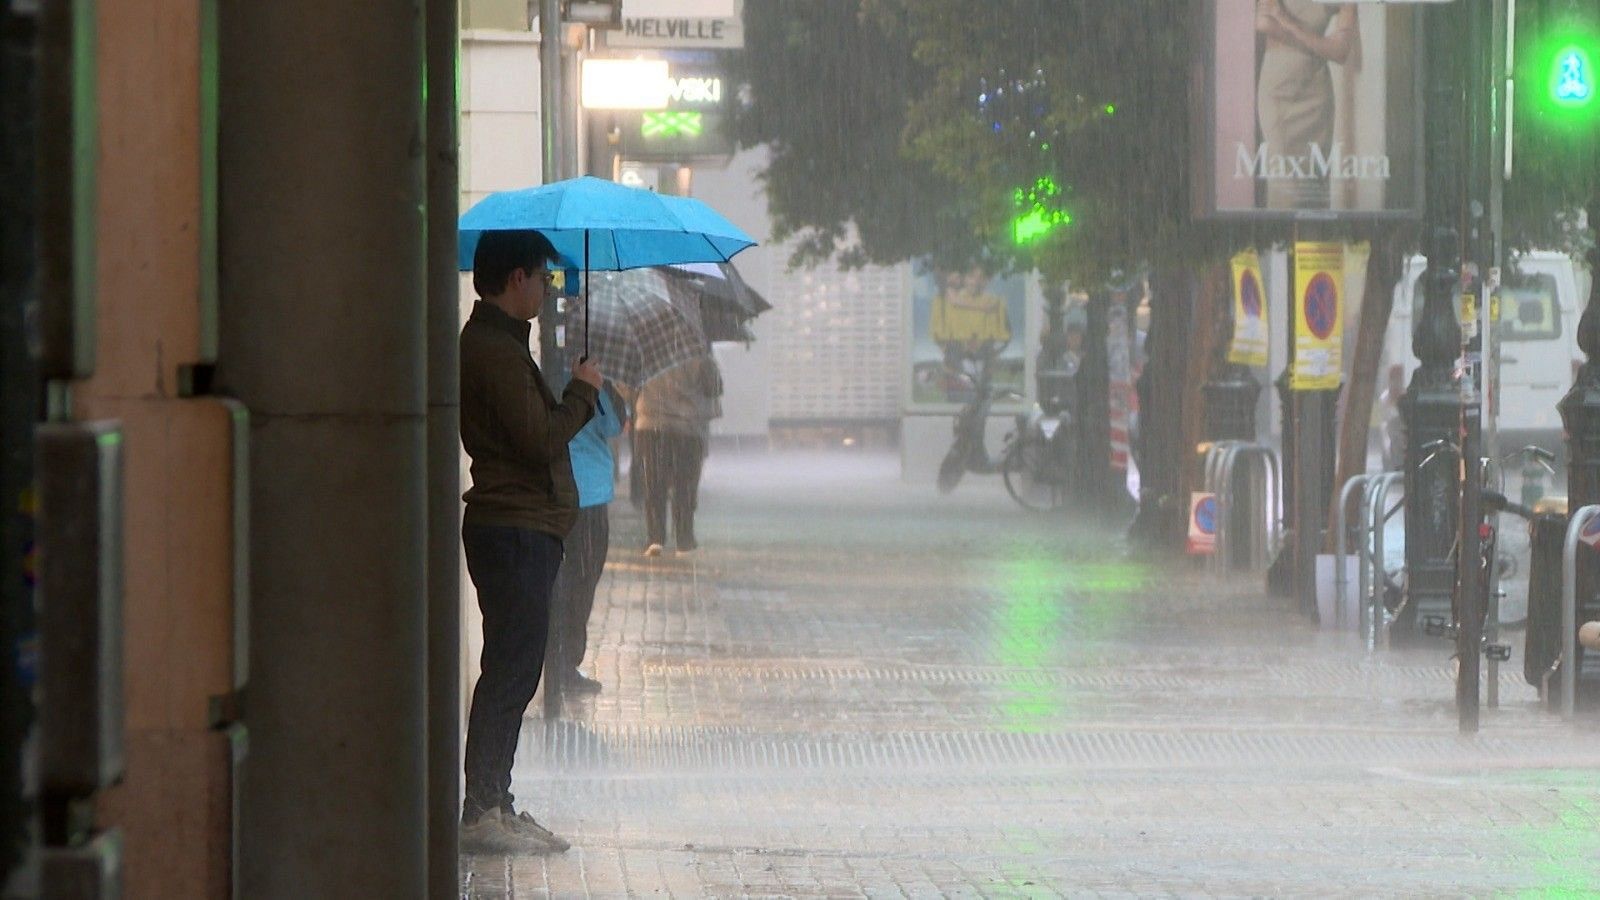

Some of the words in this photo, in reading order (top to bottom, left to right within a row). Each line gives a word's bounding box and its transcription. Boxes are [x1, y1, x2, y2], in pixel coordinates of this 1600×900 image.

[625, 18, 725, 39] MELVILLE
[665, 77, 721, 102] VSKI
[1233, 141, 1391, 179] MaxMara
